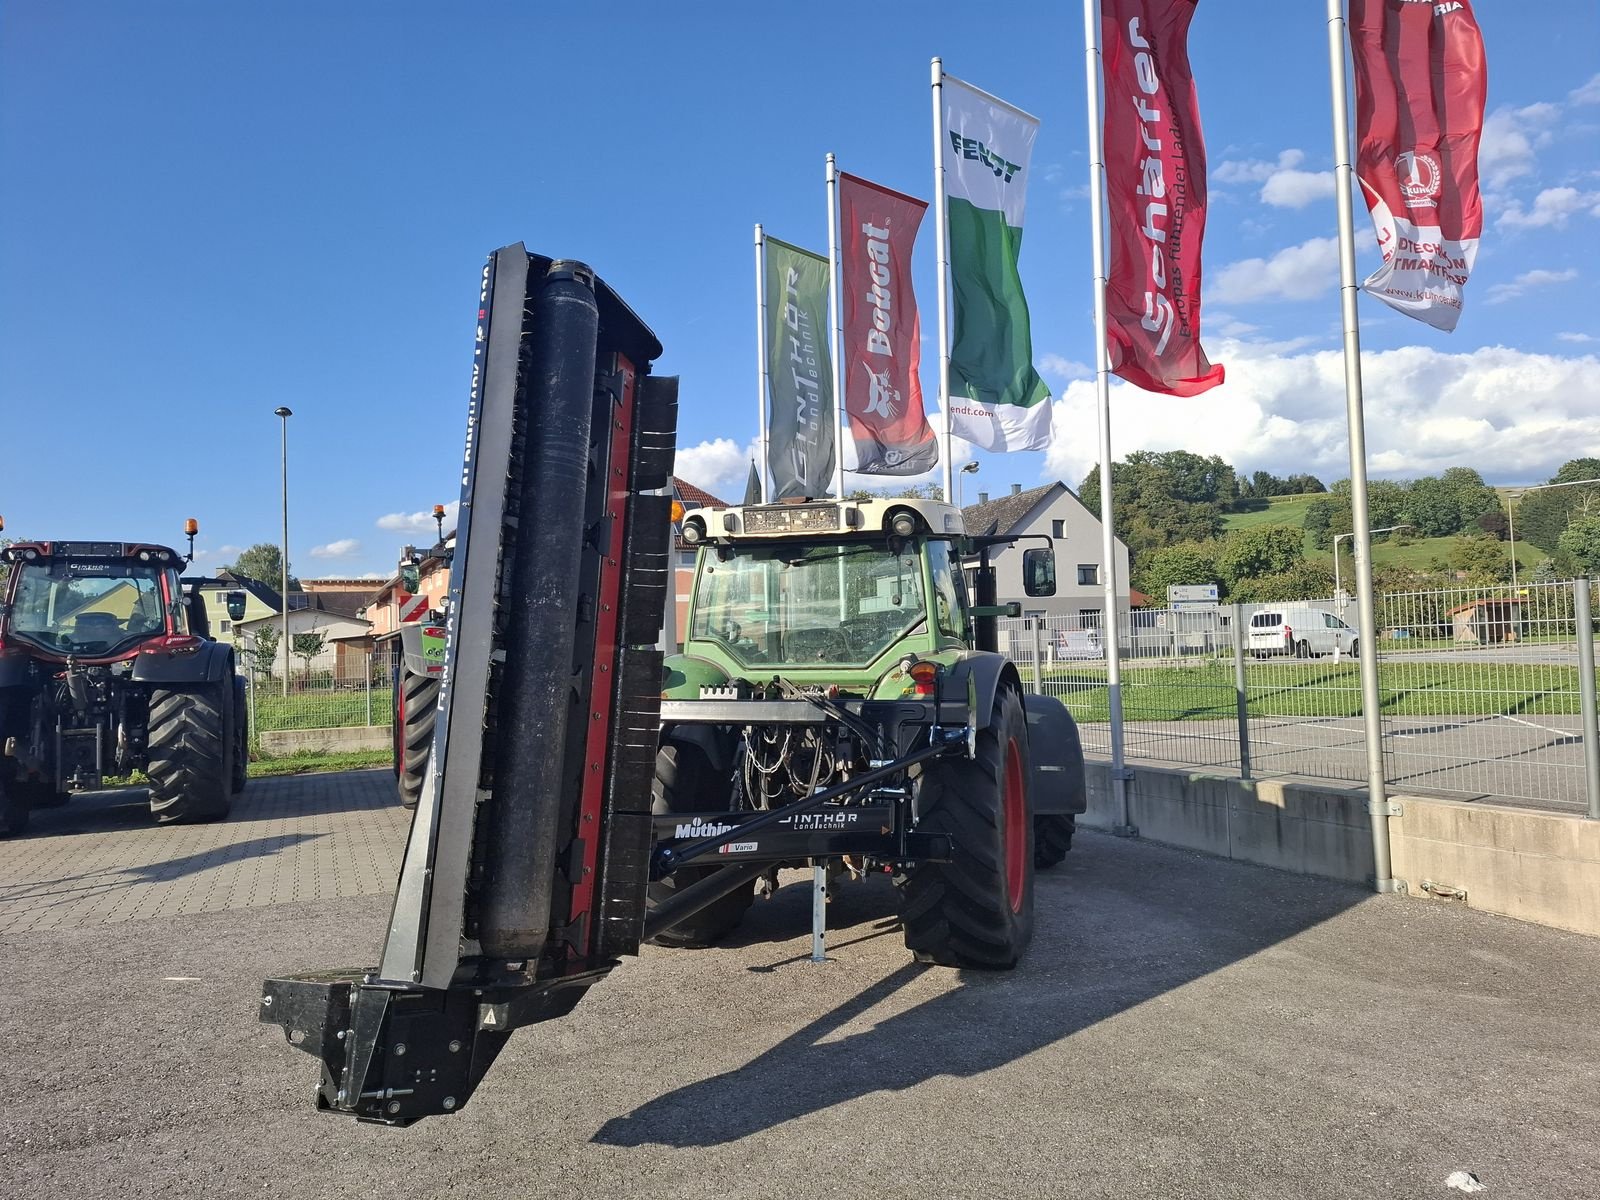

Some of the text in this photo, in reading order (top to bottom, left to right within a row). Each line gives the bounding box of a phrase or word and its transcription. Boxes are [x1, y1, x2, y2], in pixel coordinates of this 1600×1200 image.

[949, 130, 1022, 184] FENDT
[1168, 162, 1186, 261] führender
[862, 222, 893, 357] Bobcat
[1169, 267, 1191, 338] Europas
[784, 266, 818, 487] GINTHÖR
[950, 406, 994, 417] endt.com
[675, 817, 742, 839] Müthin
